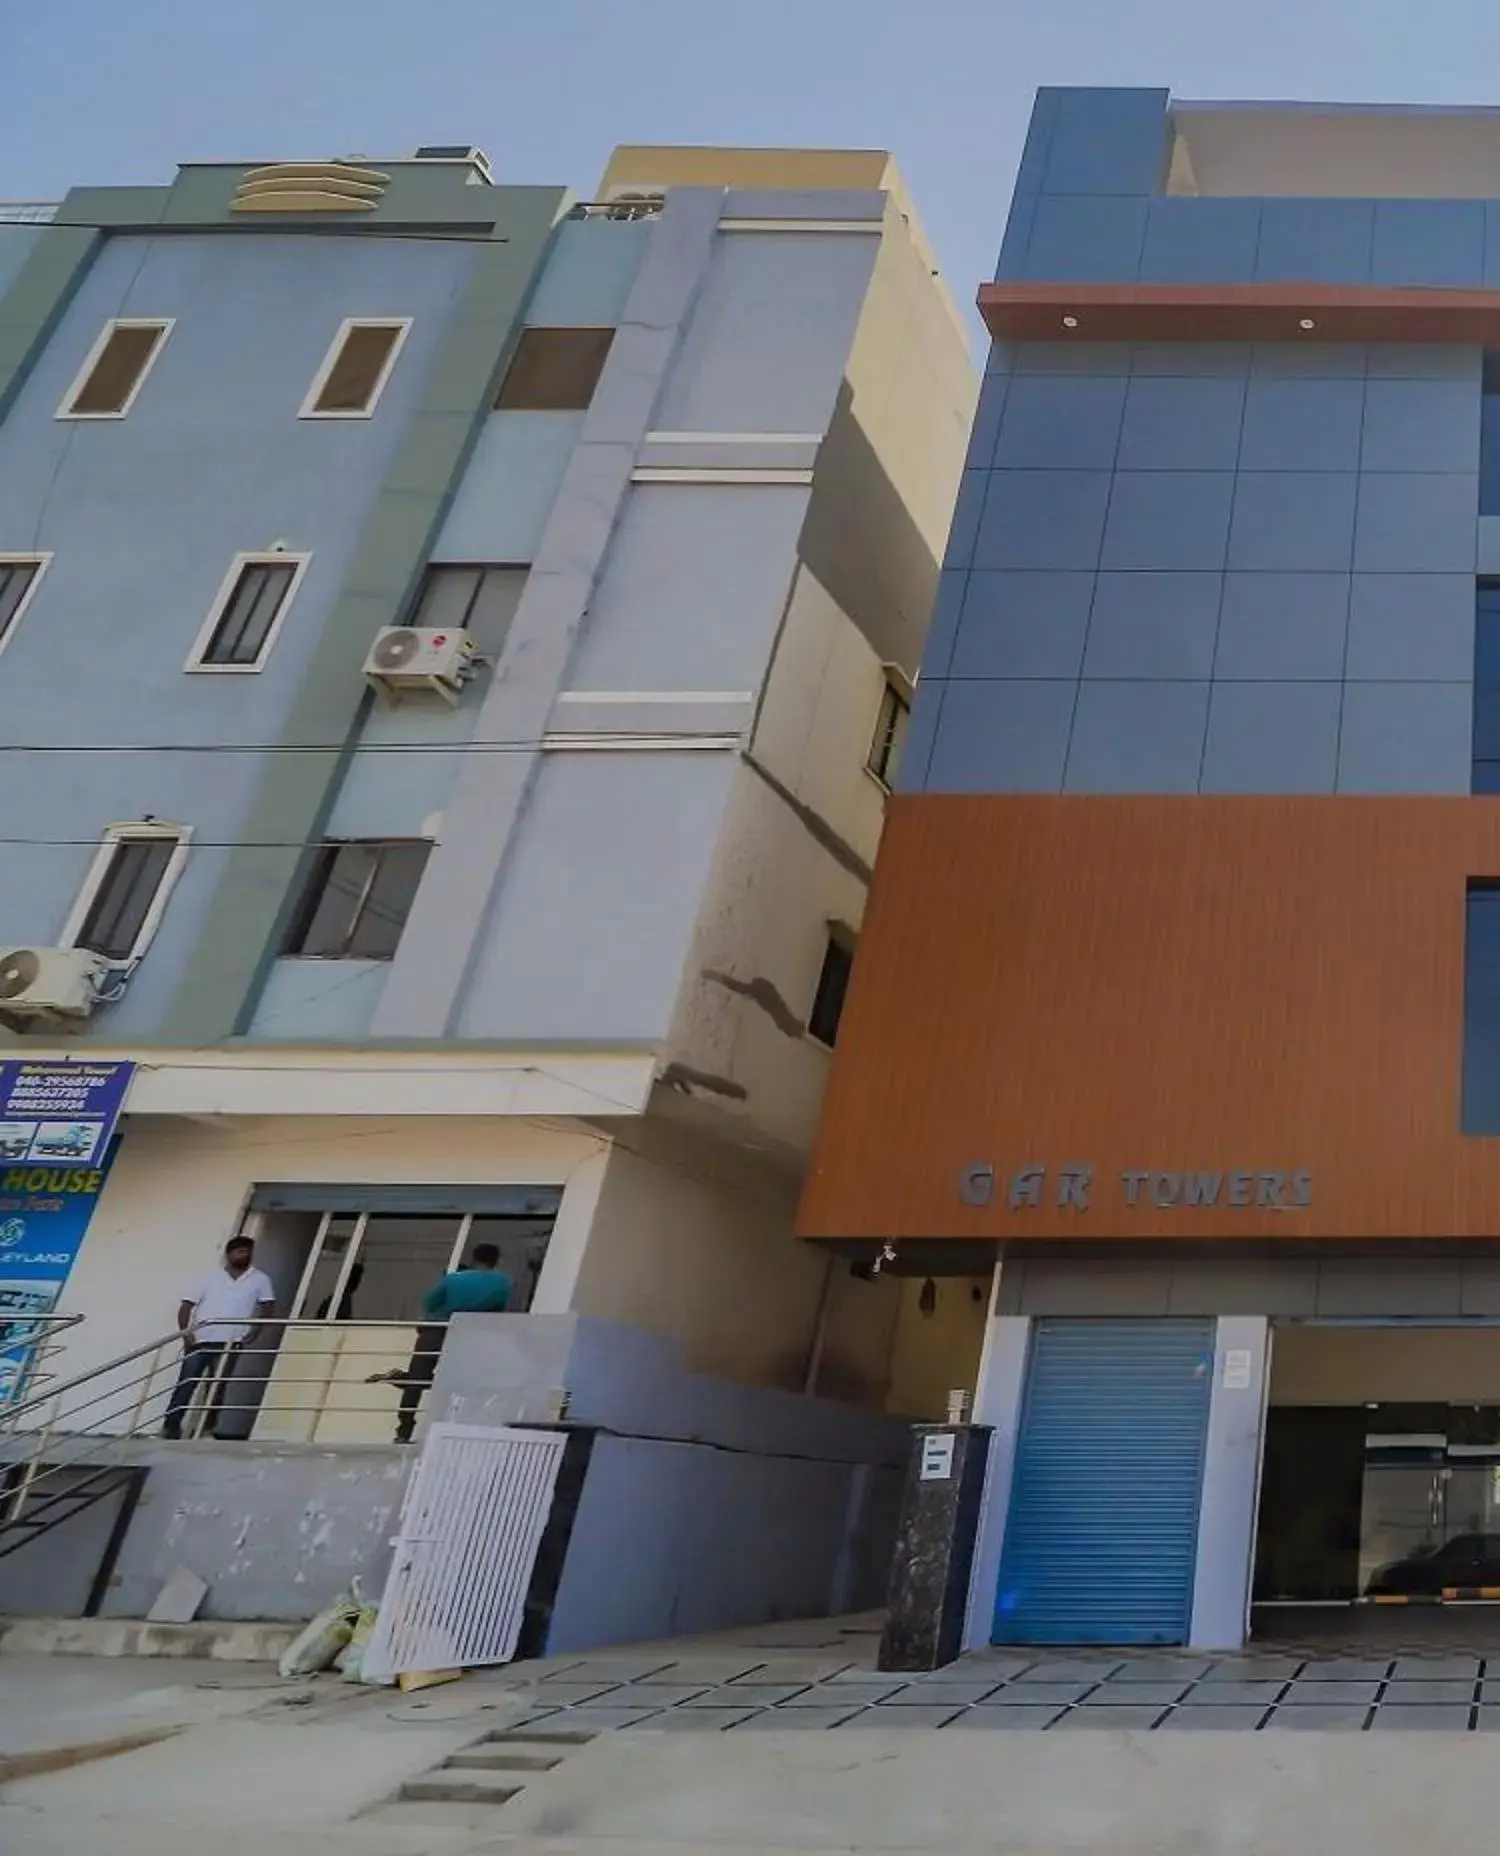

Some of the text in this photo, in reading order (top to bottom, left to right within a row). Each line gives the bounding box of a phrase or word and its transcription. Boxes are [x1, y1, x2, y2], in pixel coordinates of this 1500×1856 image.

[3, 1167, 103, 1193] HOUSE
[957, 1161, 1313, 1213] GAR TOWERS
